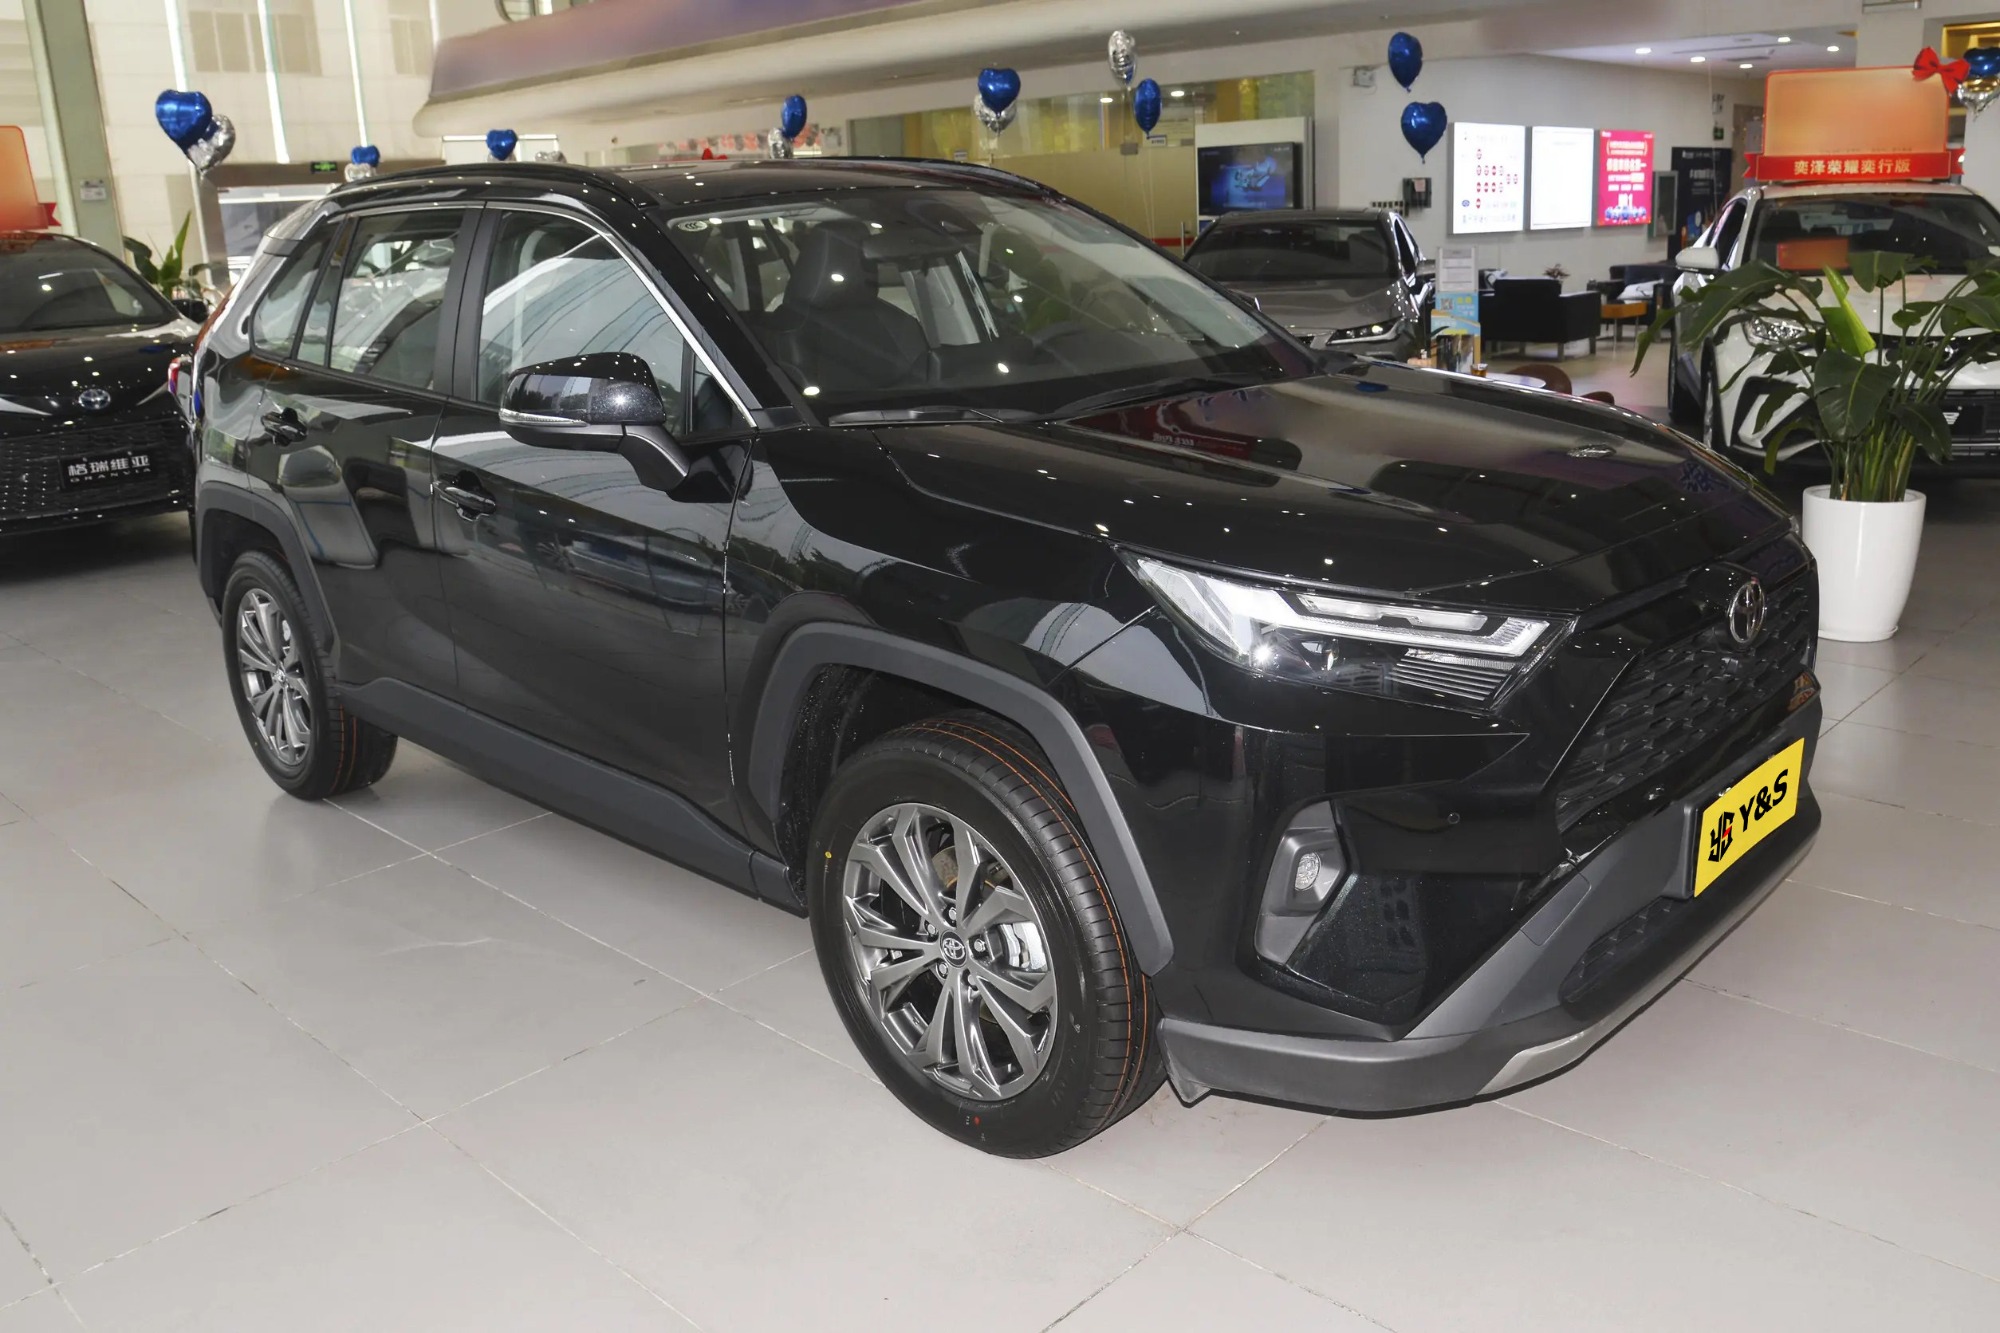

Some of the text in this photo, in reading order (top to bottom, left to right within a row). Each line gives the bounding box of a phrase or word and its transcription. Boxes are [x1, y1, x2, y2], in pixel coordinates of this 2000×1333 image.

[1794, 158, 1911, 175] 奕泽荣耀奕行版
[68, 455, 150, 477] 格瑞维亚
[1739, 768, 1789, 832] Y&S
